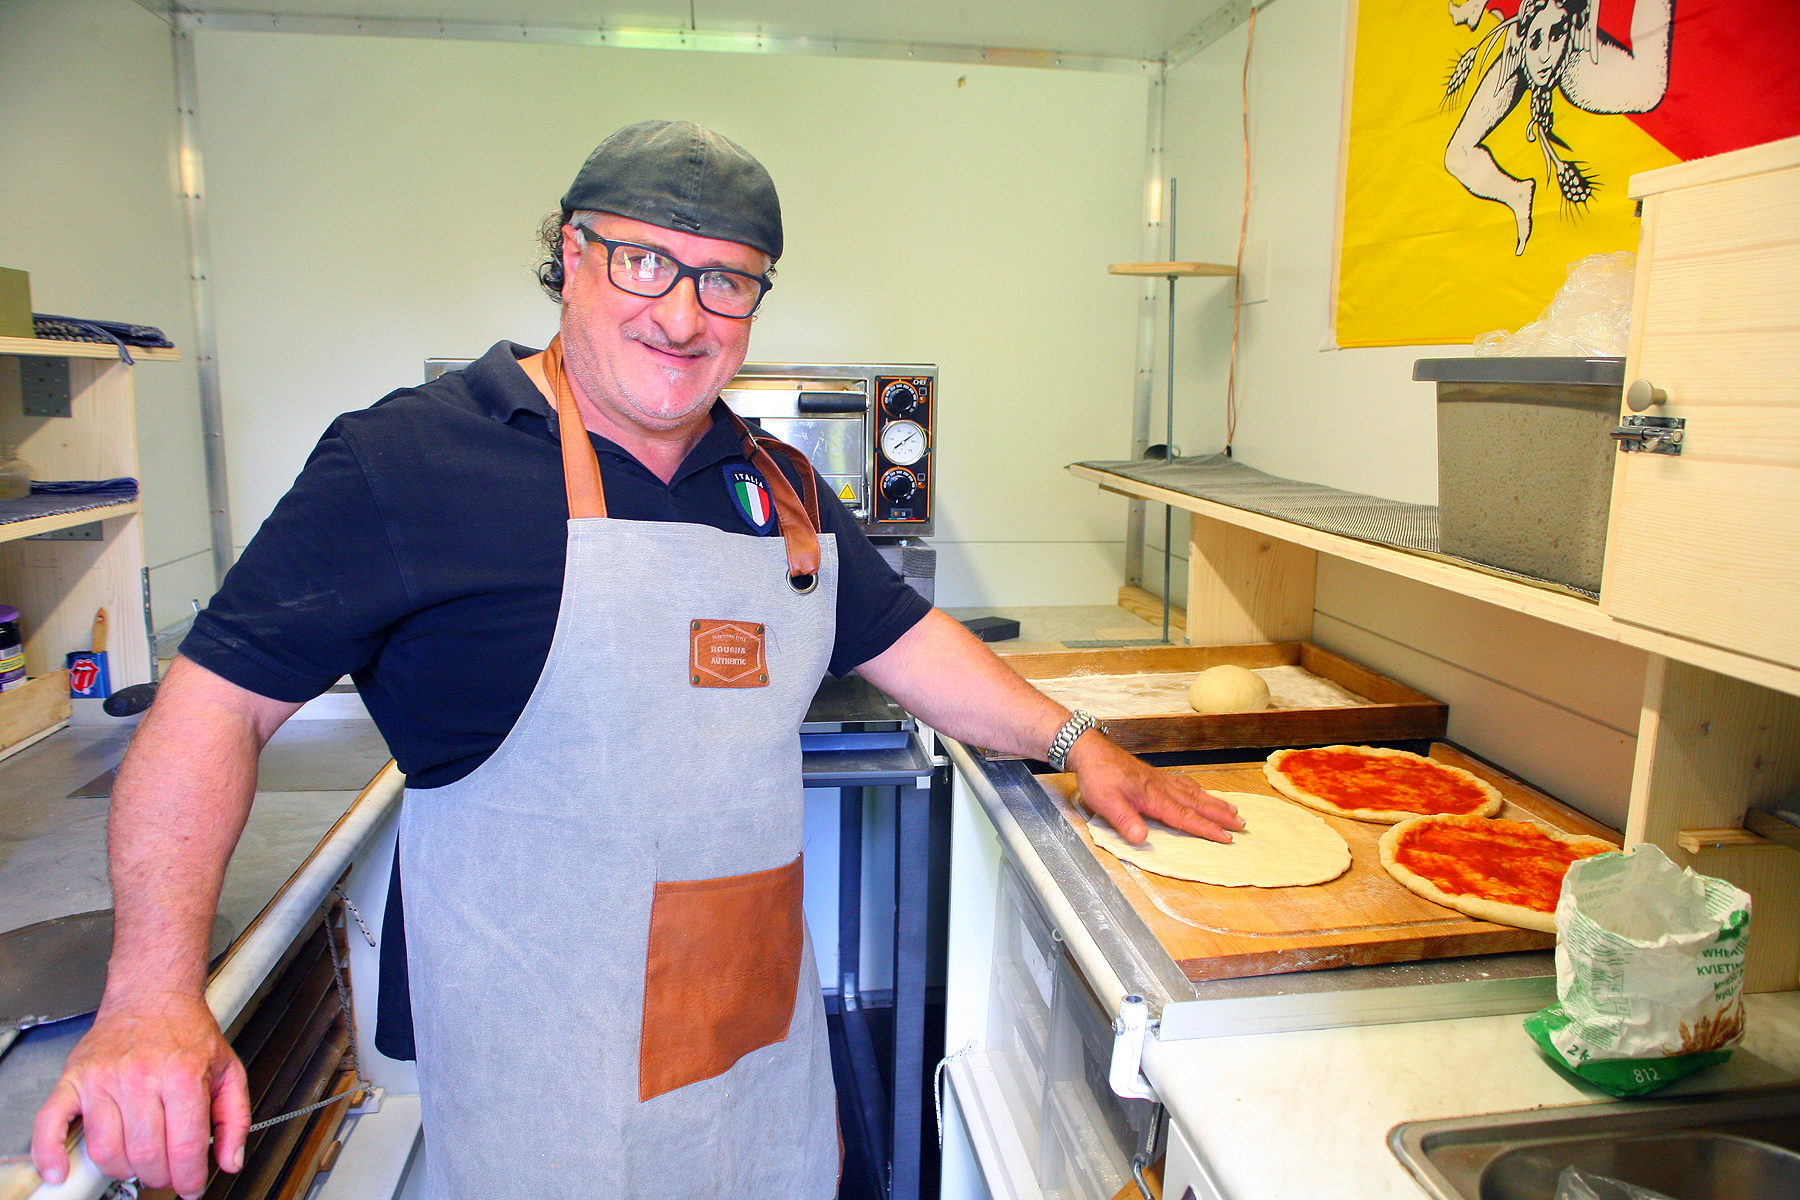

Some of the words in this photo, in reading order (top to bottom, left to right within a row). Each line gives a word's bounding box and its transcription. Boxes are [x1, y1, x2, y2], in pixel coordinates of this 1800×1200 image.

[734, 473, 764, 489] ITALIA
[710, 657, 747, 666] AUTHENTIC
[1566, 1044, 1580, 1057] 2
[1579, 1049, 1591, 1061] k
[1633, 1067, 1661, 1084] 812
